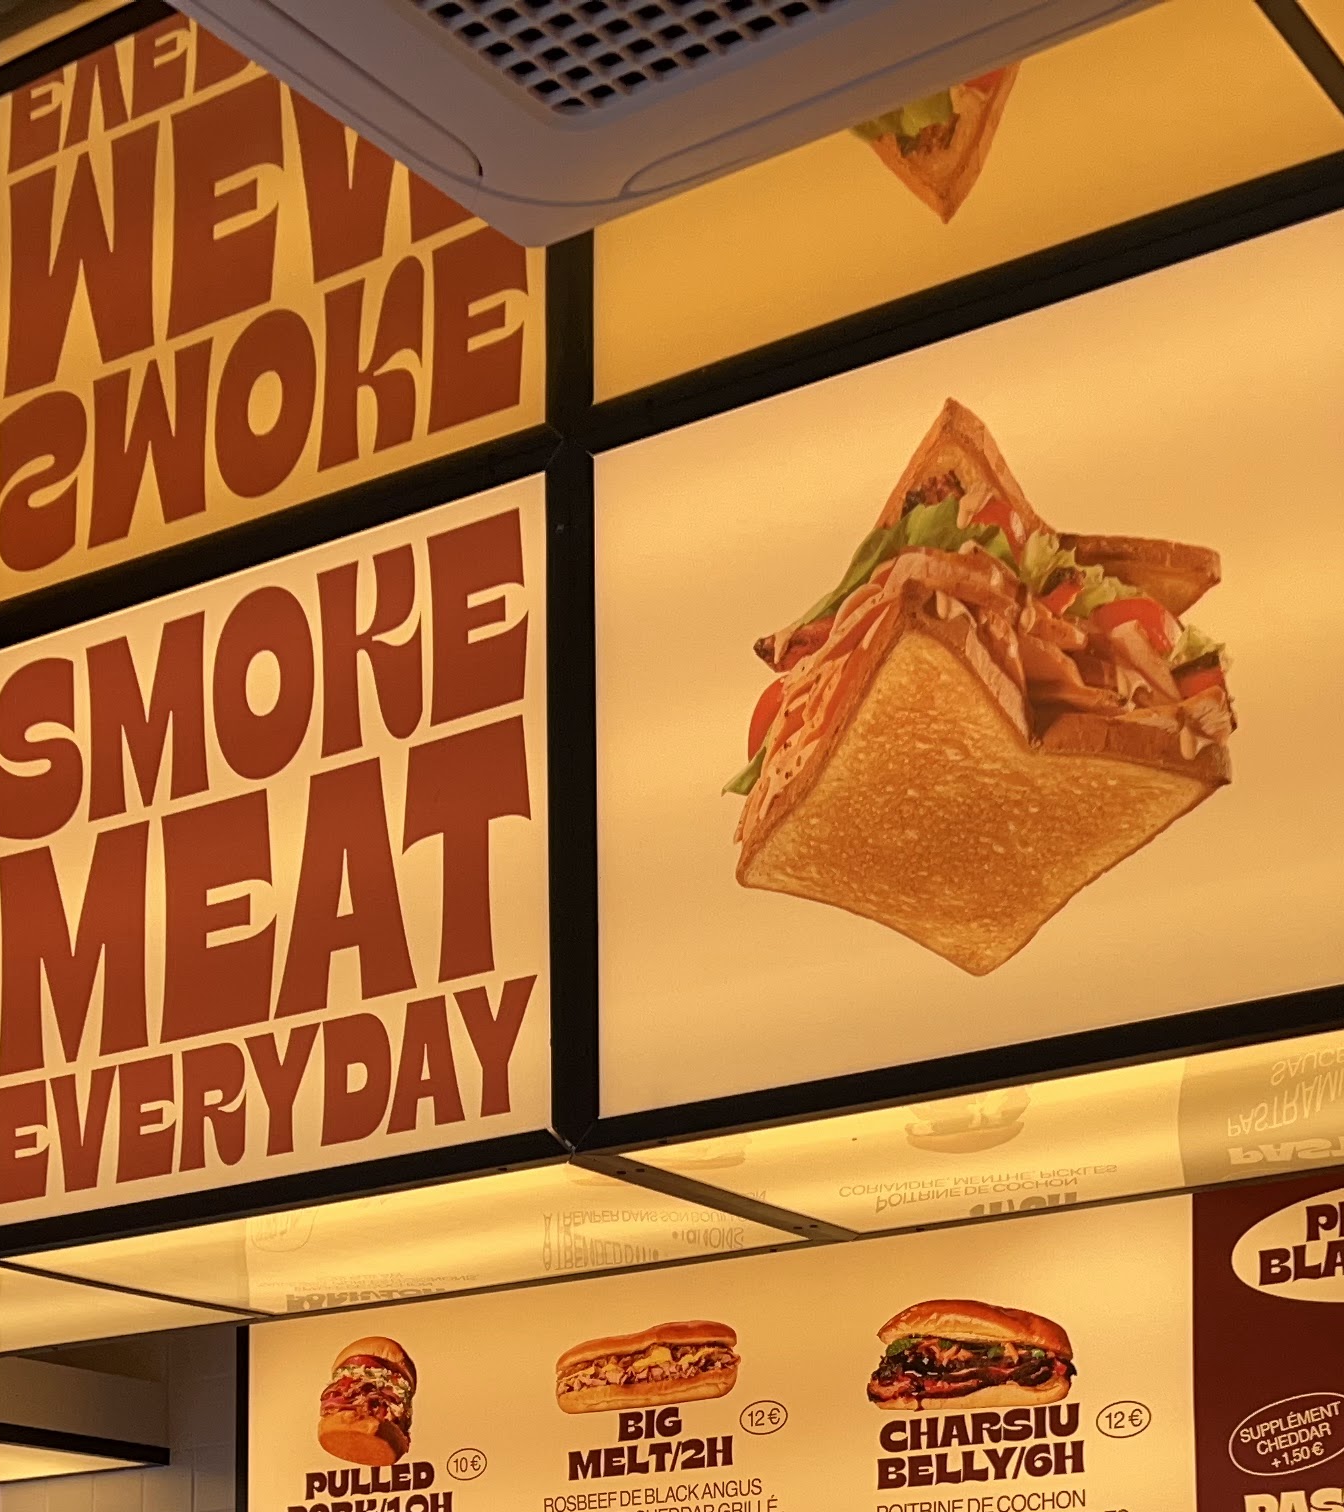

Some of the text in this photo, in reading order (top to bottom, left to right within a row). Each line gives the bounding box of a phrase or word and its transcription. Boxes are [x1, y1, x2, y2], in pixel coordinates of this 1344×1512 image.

[617, 1406, 683, 1443] BIG
[879, 1402, 1080, 1453] CHARSIU
[1239, 1400, 1341, 1444] SUPPLÉMENT
[1256, 1421, 1332, 1456] CHEDDAR
[568, 1435, 734, 1481] MELT/2H
[877, 1439, 1085, 1491] BELLY/6H
[305, 1460, 435, 1501] PULLED
[619, 1488, 643, 1508] DE
[644, 1483, 700, 1505] BLACK
[700, 1477, 763, 1500] ANGUS
